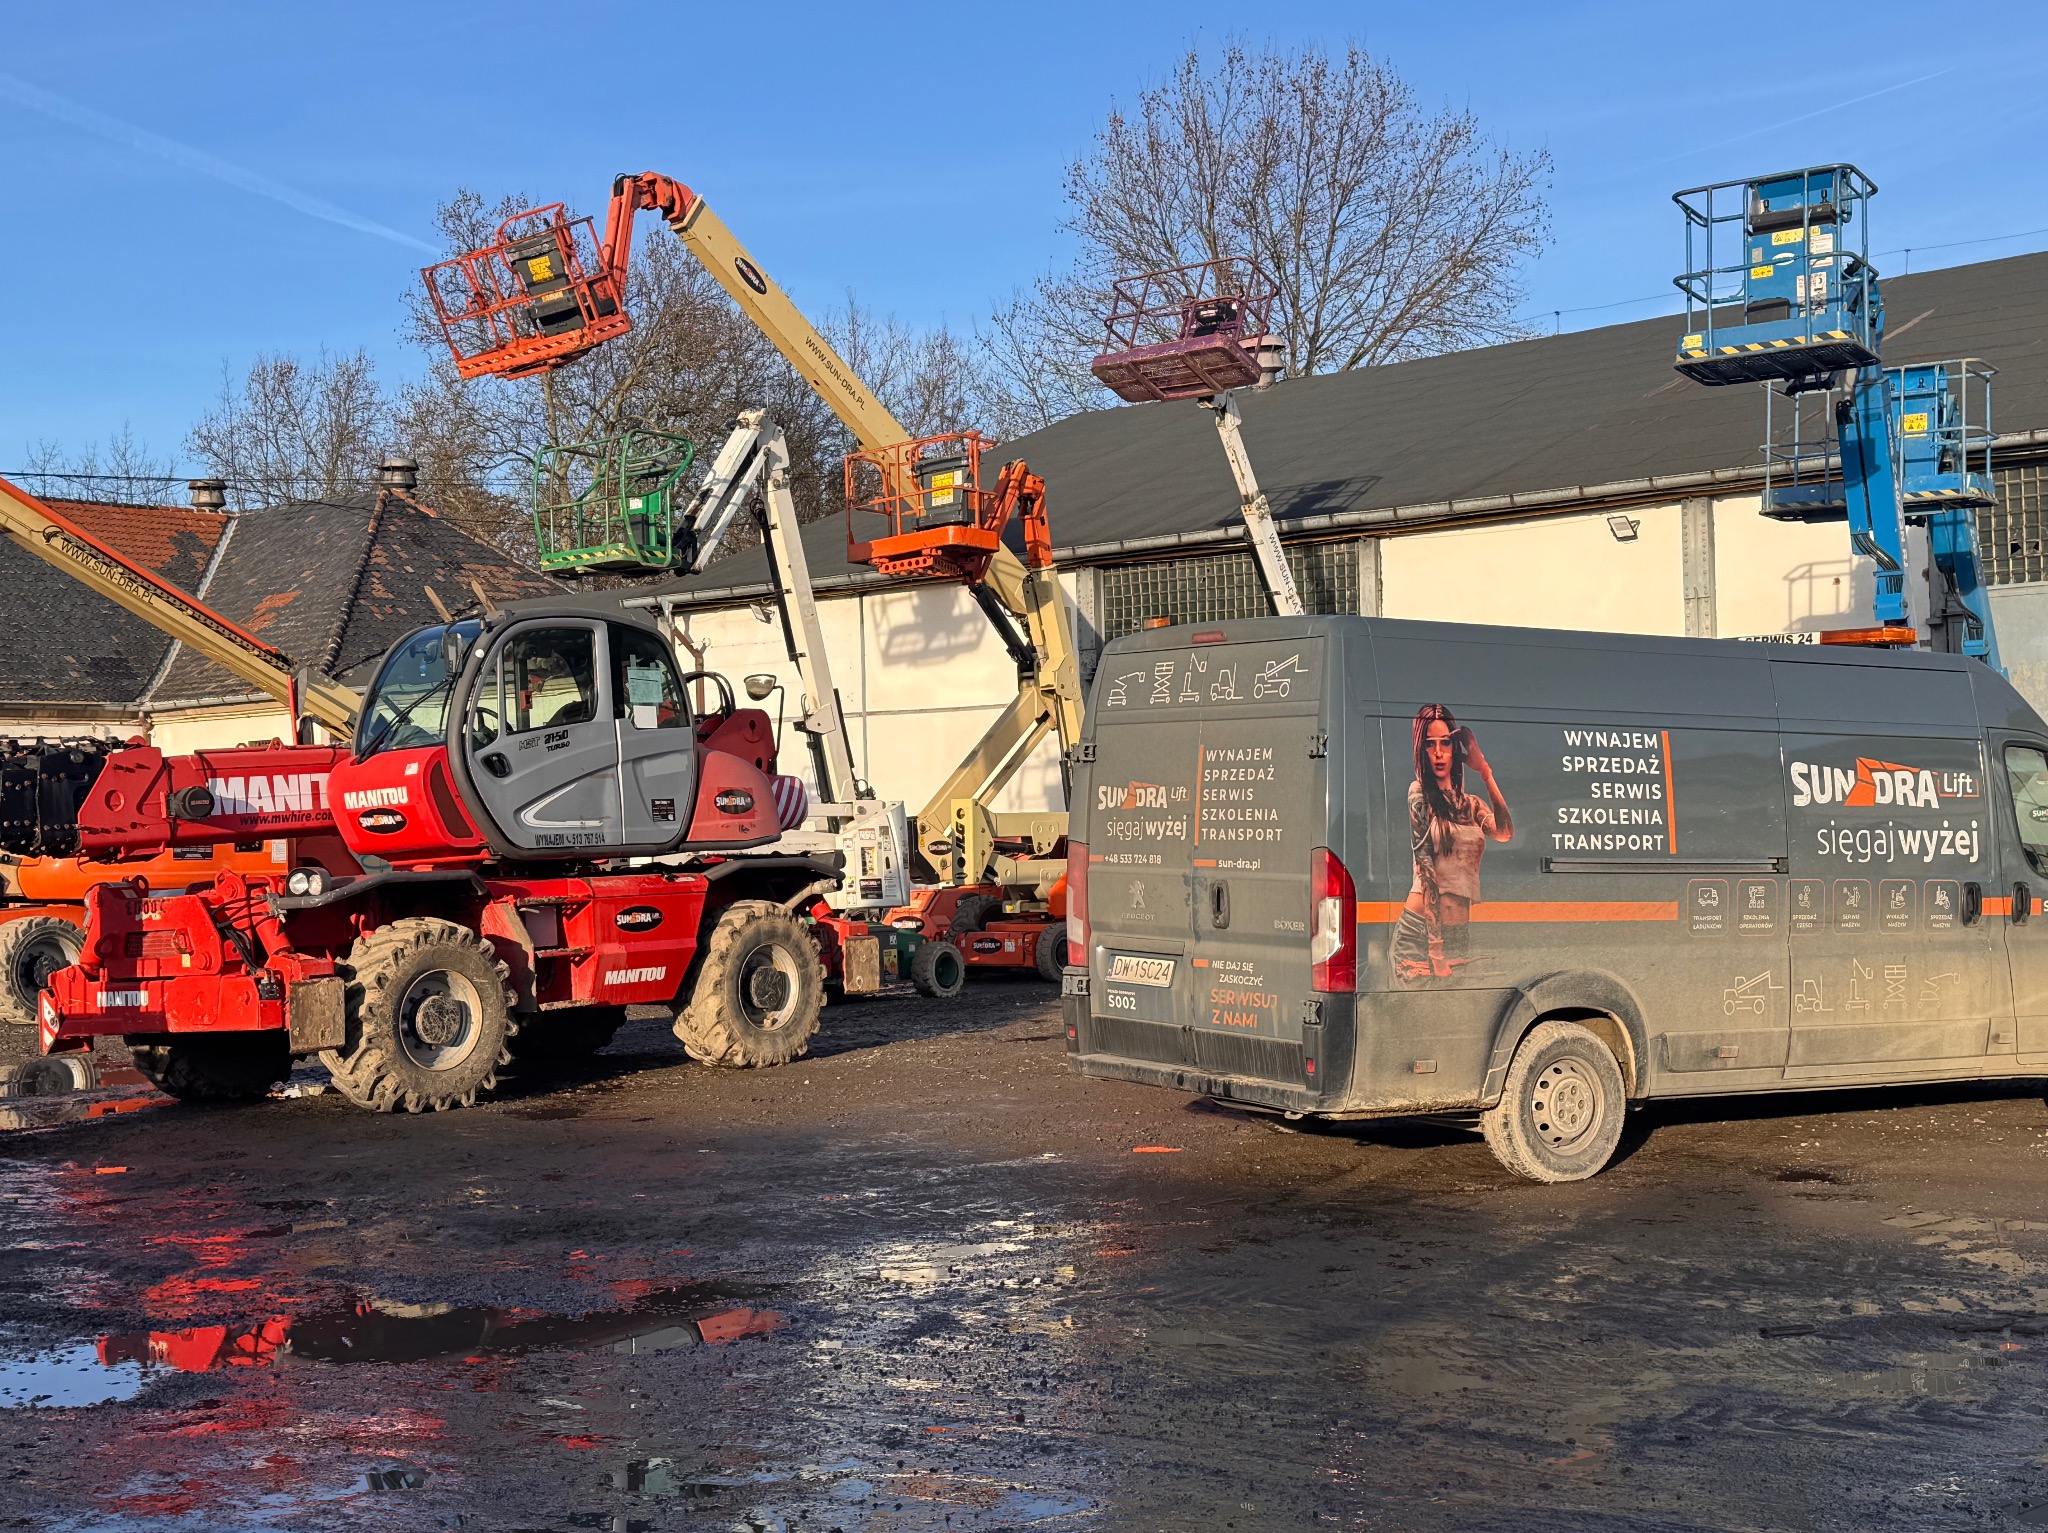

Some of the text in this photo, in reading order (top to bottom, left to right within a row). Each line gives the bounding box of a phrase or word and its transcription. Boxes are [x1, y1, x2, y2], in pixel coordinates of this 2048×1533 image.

[805, 336, 865, 411] WWW.SUN-DRA.PL
[61, 540, 154, 605] WWW.SUN-DRA.PL
[1798, 633, 1813, 645] 24
[544, 729, 569, 744] 2150
[1563, 730, 1658, 749] WYNAJEM
[546, 741, 570, 752] TURBO
[1206, 748, 1273, 761] WYNAJEM
[1204, 764, 1275, 781] SPRZEDAŻ
[1562, 754, 1660, 774] SPRZEDAŻ
[1170, 786, 1187, 801] Lift
[1591, 782, 1662, 800] SERWIS
[1943, 772, 1973, 798] Lift
[344, 786, 409, 809] MANITOU
[1203, 788, 1254, 801] SERWIS
[1201, 808, 1279, 821] SZKOLENIA
[1558, 807, 1664, 825] SZKOLENIA
[1107, 815, 1187, 840] sięgaj wyżej
[1201, 828, 1283, 841] TRANSPORT
[535, 832, 606, 846] WYNAJEM 513 767 514
[955, 821, 966, 854] JLG
[1552, 833, 1664, 851] TRANSPORT
[1817, 820, 1979, 863] sięgaj wyżej
[1104, 854, 1162, 865] +48 533 724 818
[1218, 858, 1261, 870] sun-dra.pl
[1121, 912, 1155, 921] PEUGEOT
[1273, 919, 1305, 932] BOXER
[604, 966, 667, 985] MANITOU
[1114, 958, 1171, 981] DW 1SC24
[1212, 960, 1254, 974] NIE DAJ SIĘ
[1219, 974, 1264, 987] ZASKOCZYĆ
[96, 990, 149, 1008] MANITOU
[1108, 994, 1136, 1010] S002
[1210, 988, 1278, 1009] SERWISUJ
[1212, 1009, 1258, 1028] Z NAMI
